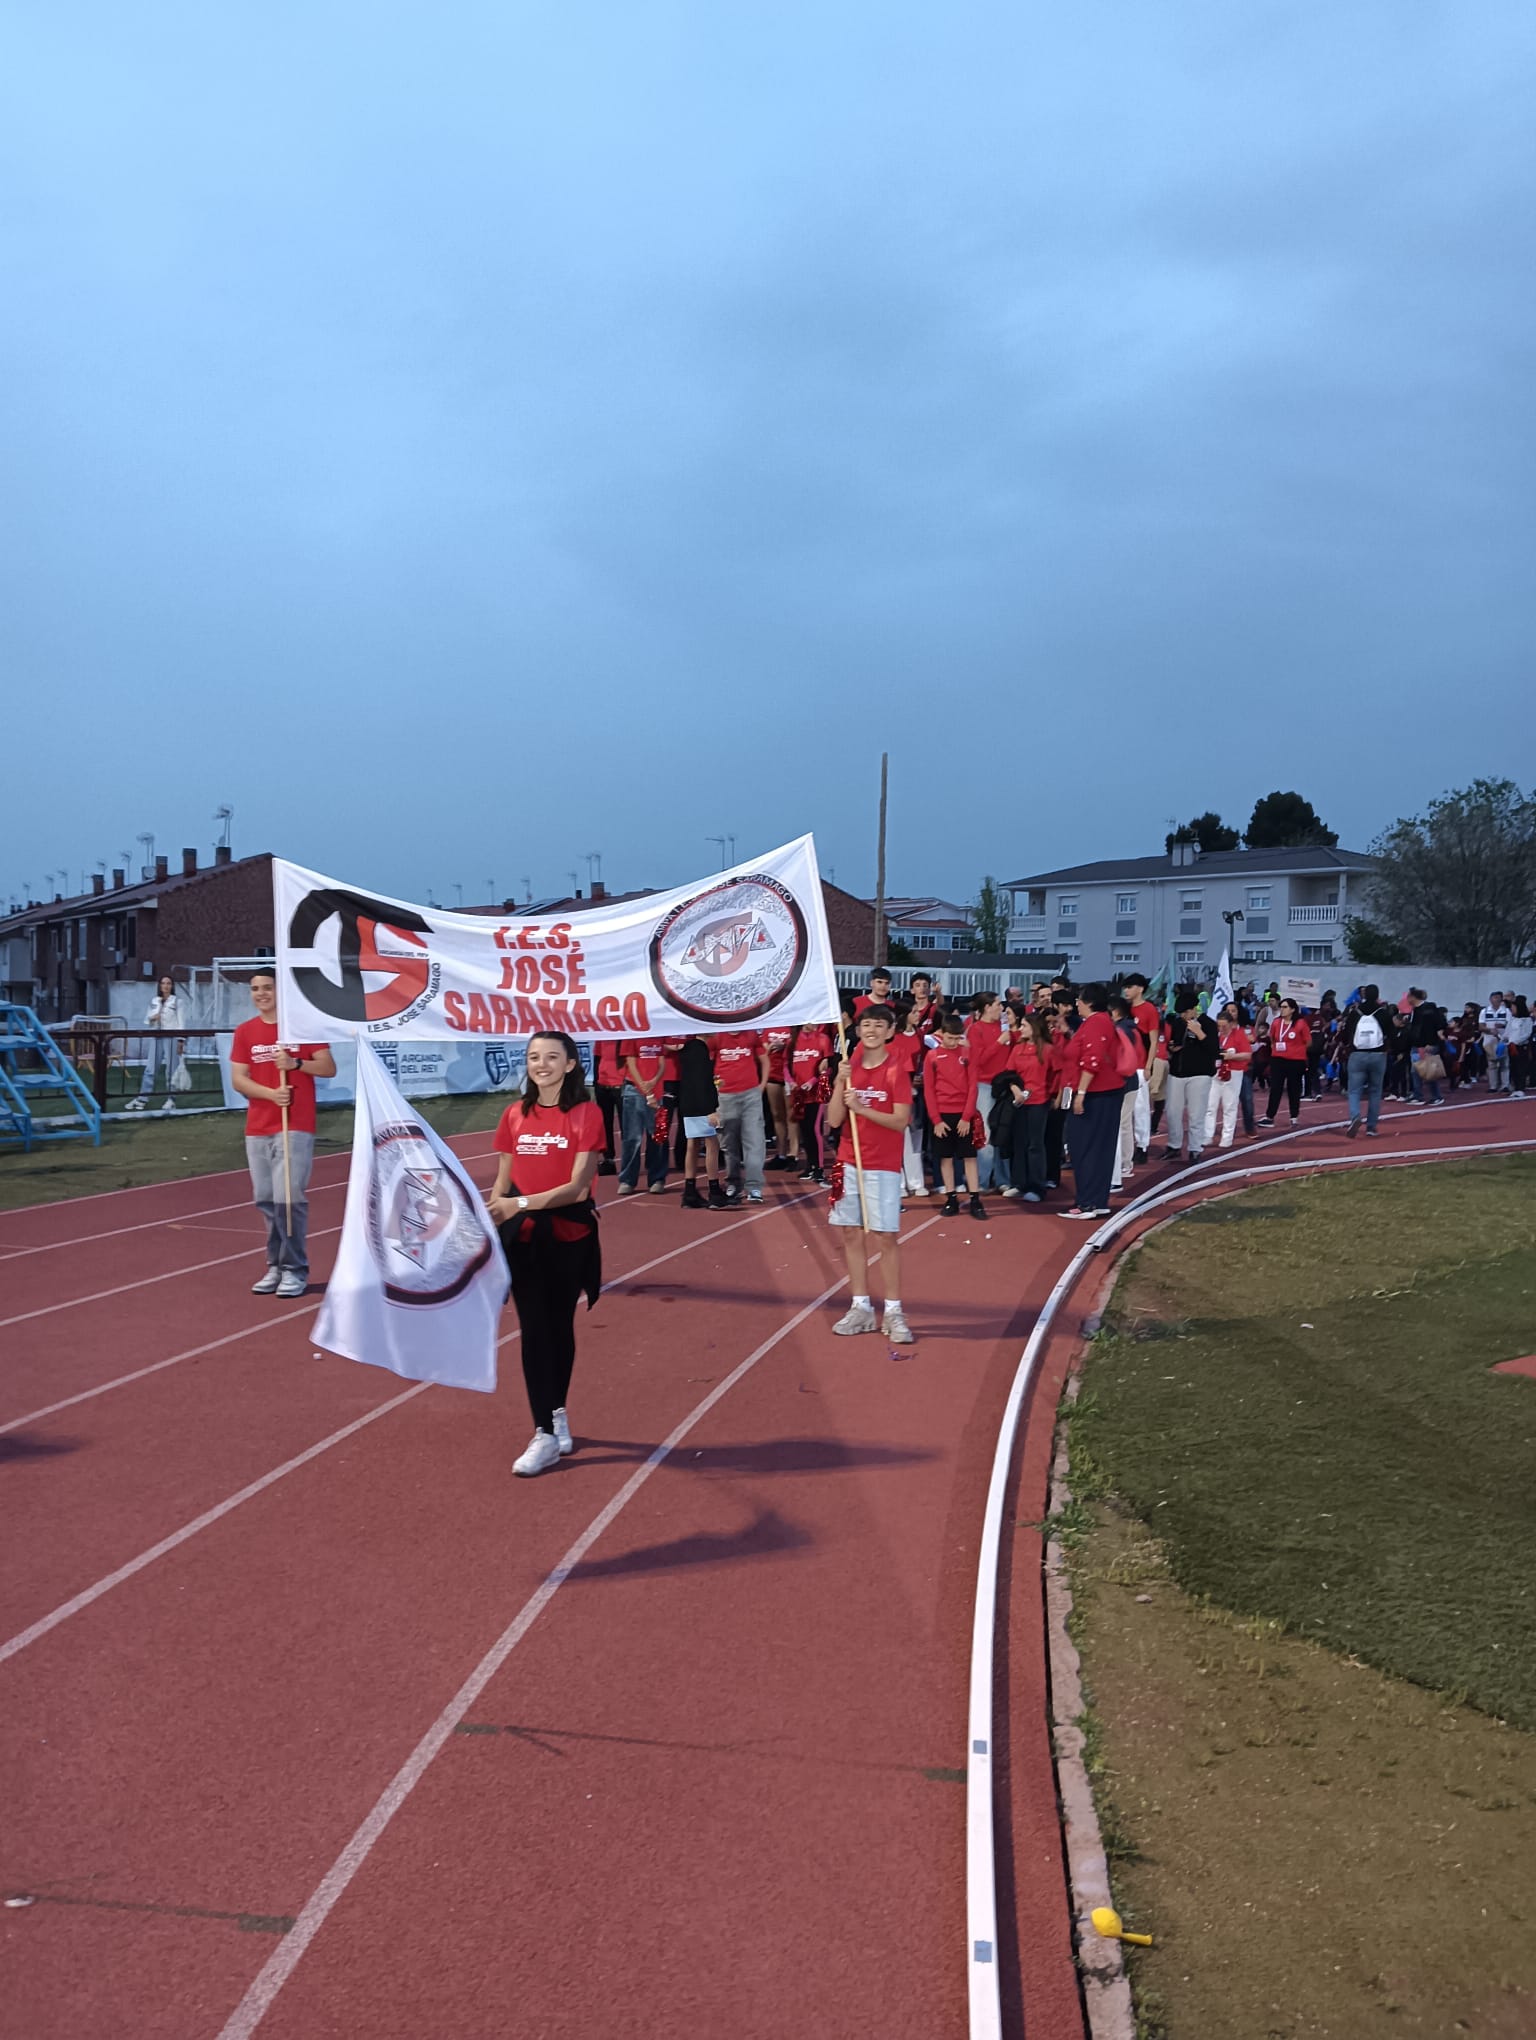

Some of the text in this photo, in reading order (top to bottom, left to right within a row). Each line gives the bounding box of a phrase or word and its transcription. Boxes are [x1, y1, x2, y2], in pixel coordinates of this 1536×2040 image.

[736, 874, 792, 902] SARAMAGO
[493, 922, 581, 950] I.E.S.
[416, 962, 441, 1011] SARAMAGO
[496, 948, 587, 995] JOSÉ
[443, 991, 651, 1034] SARAMAGO
[401, 1064, 420, 1074] DEL
